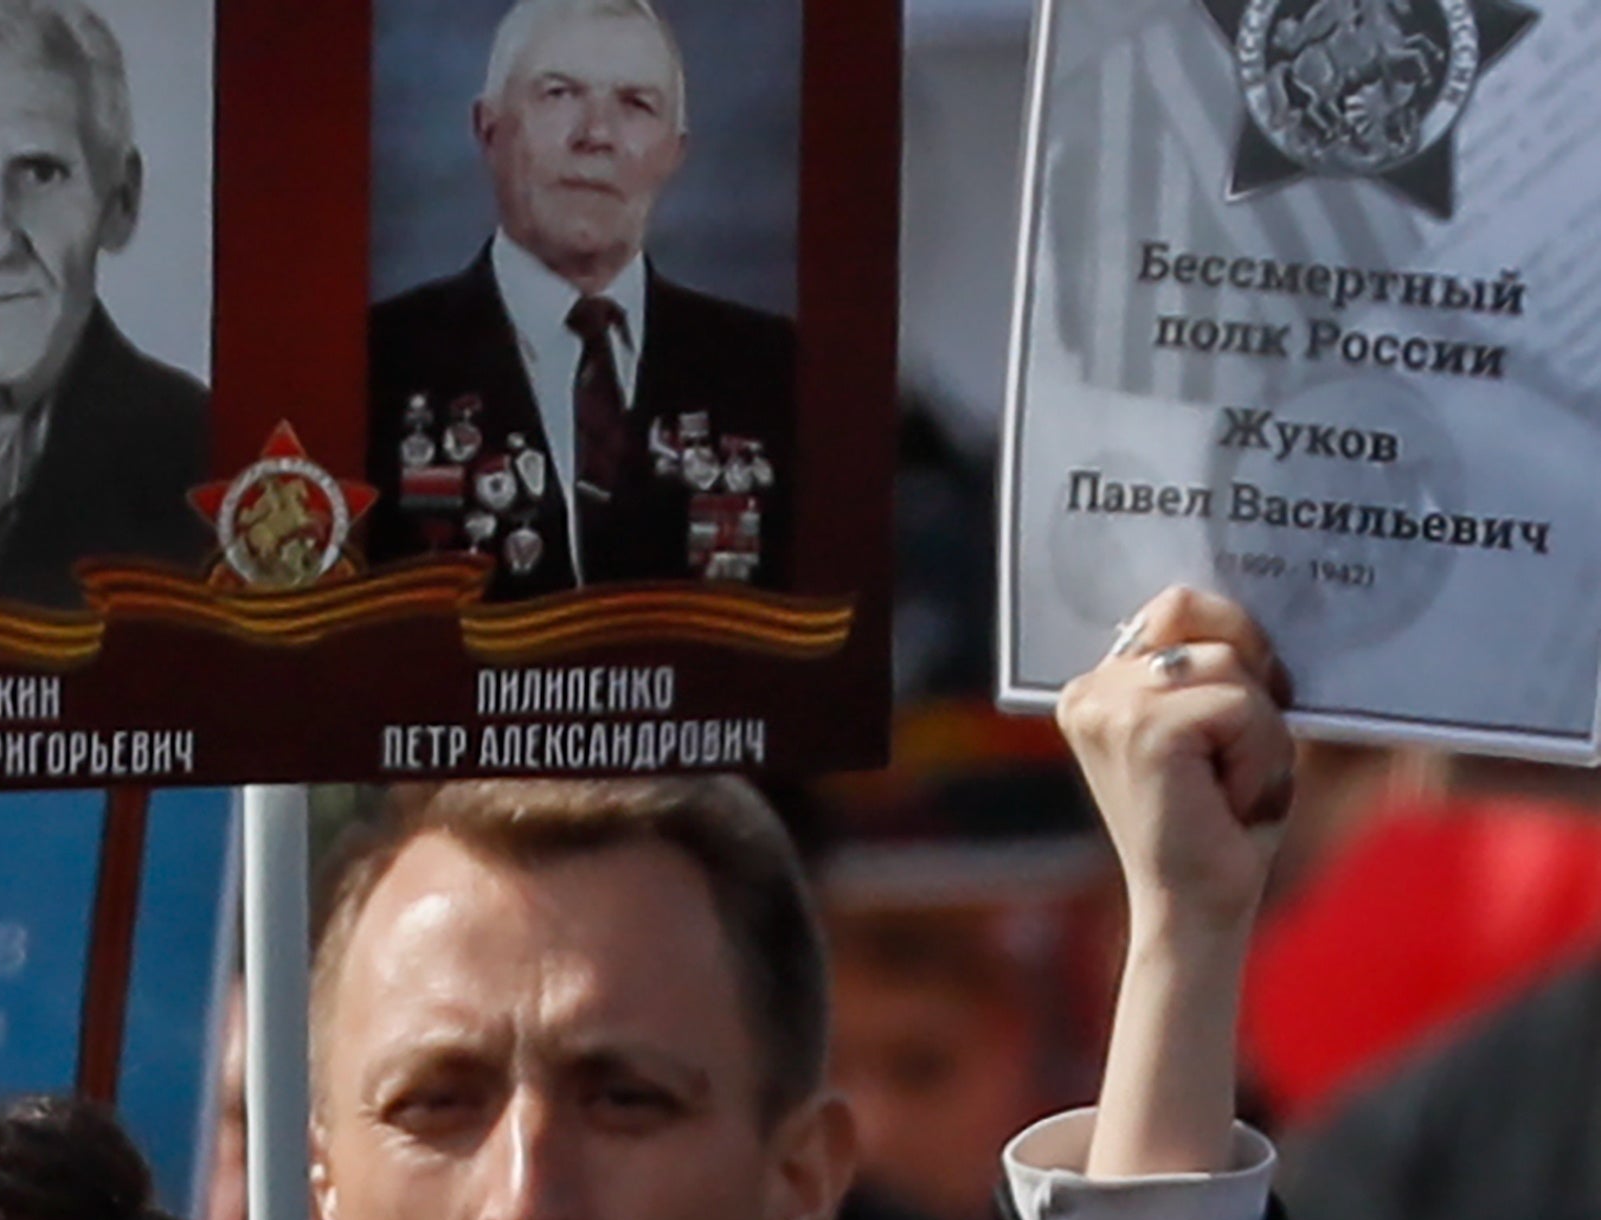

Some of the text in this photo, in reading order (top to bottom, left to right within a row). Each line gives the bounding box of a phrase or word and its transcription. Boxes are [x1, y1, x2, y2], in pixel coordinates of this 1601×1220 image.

[1138, 241, 1527, 315] Бессмертный
[1153, 313, 1509, 378] полк России
[1219, 406, 1398, 463] Жуков
[1066, 470, 1550, 553] Павел Васильевич
[477, 665, 676, 715] ПИЛИПЕНКО
[383, 719, 765, 771] ПЕТР АЛЕКСАНДРОВИЧ
